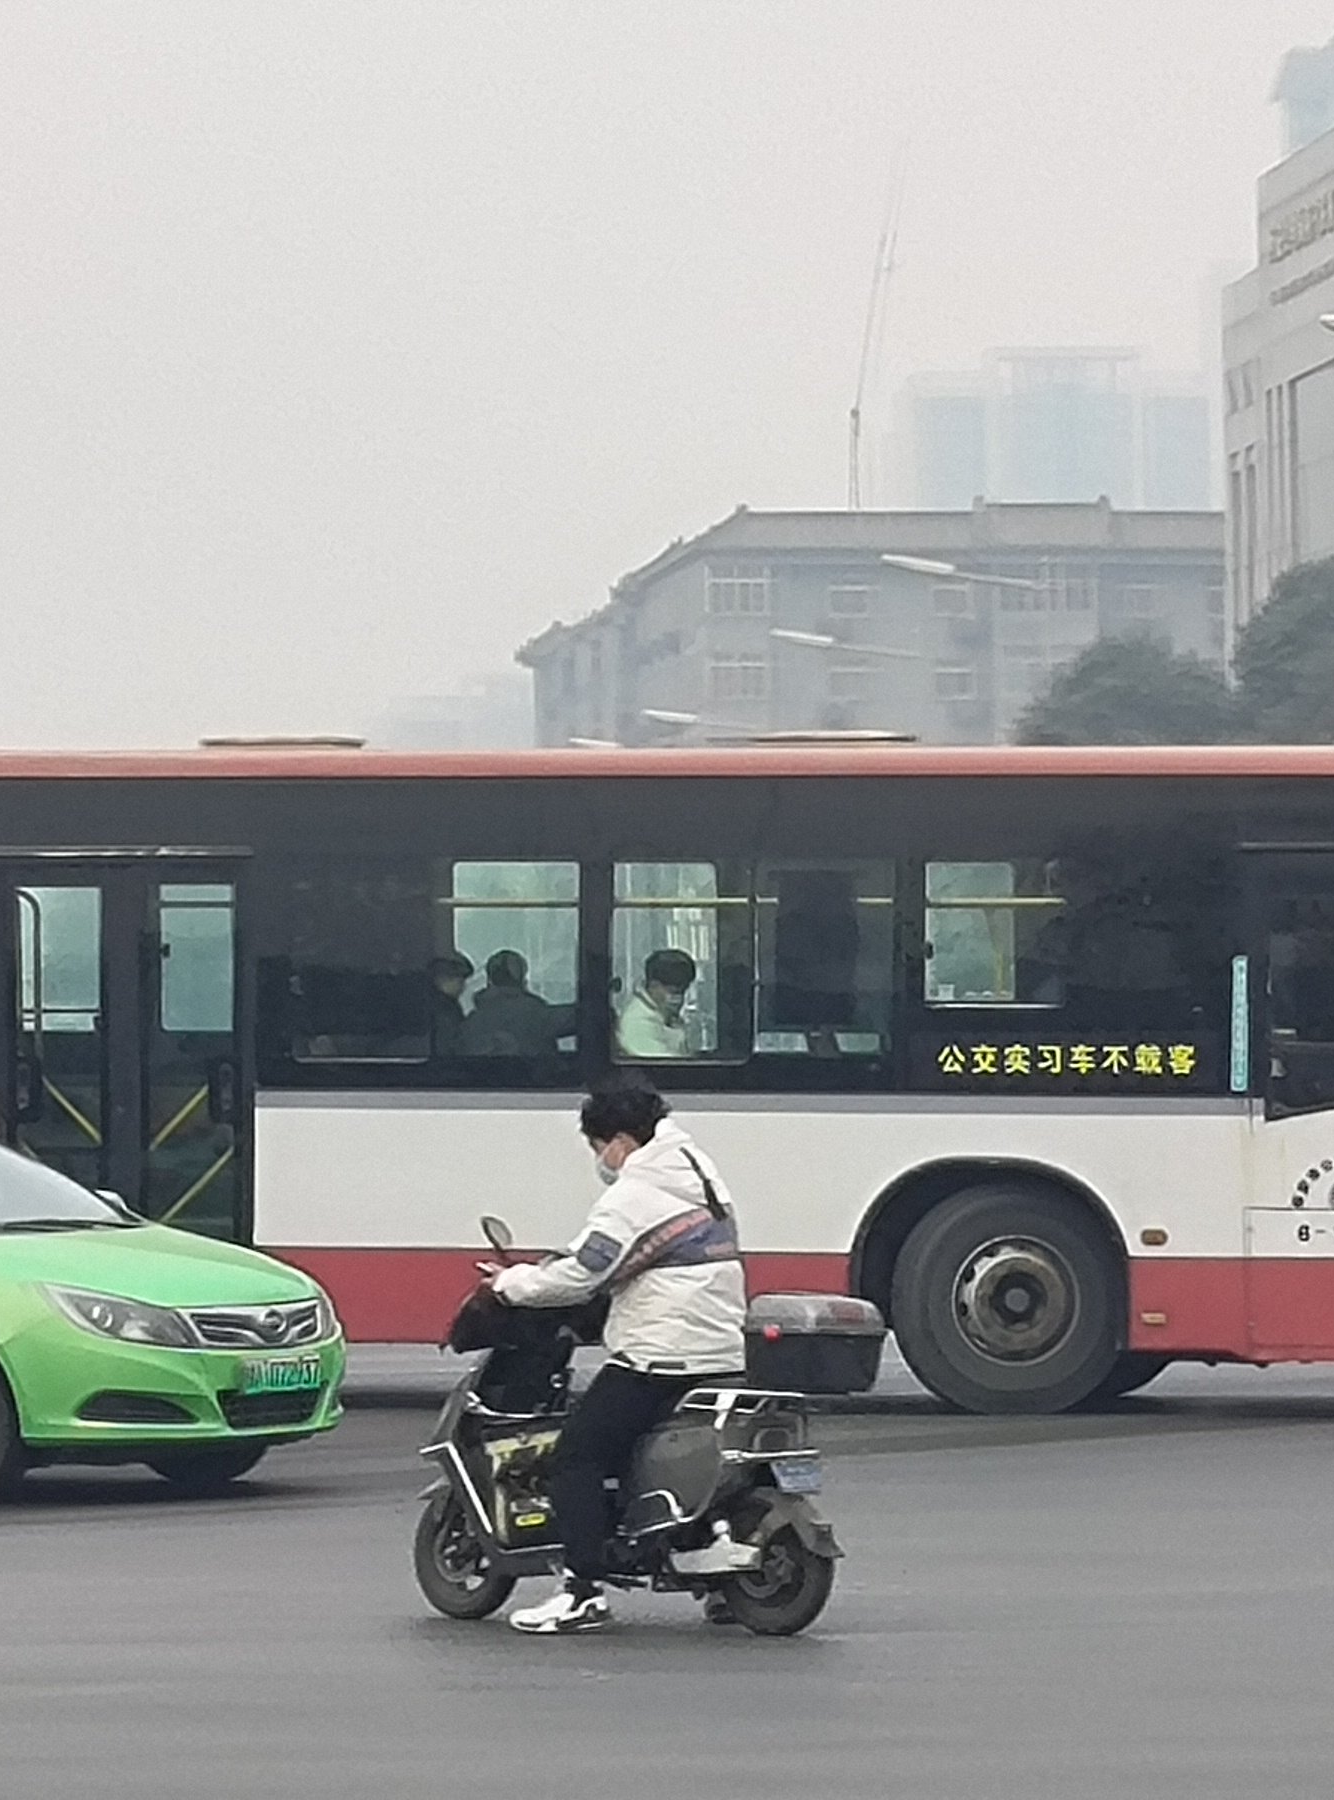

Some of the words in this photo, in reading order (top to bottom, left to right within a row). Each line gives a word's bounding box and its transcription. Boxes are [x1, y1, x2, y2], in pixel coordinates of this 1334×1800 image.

[937, 1043, 1197, 1075] 公交实习车不载客
